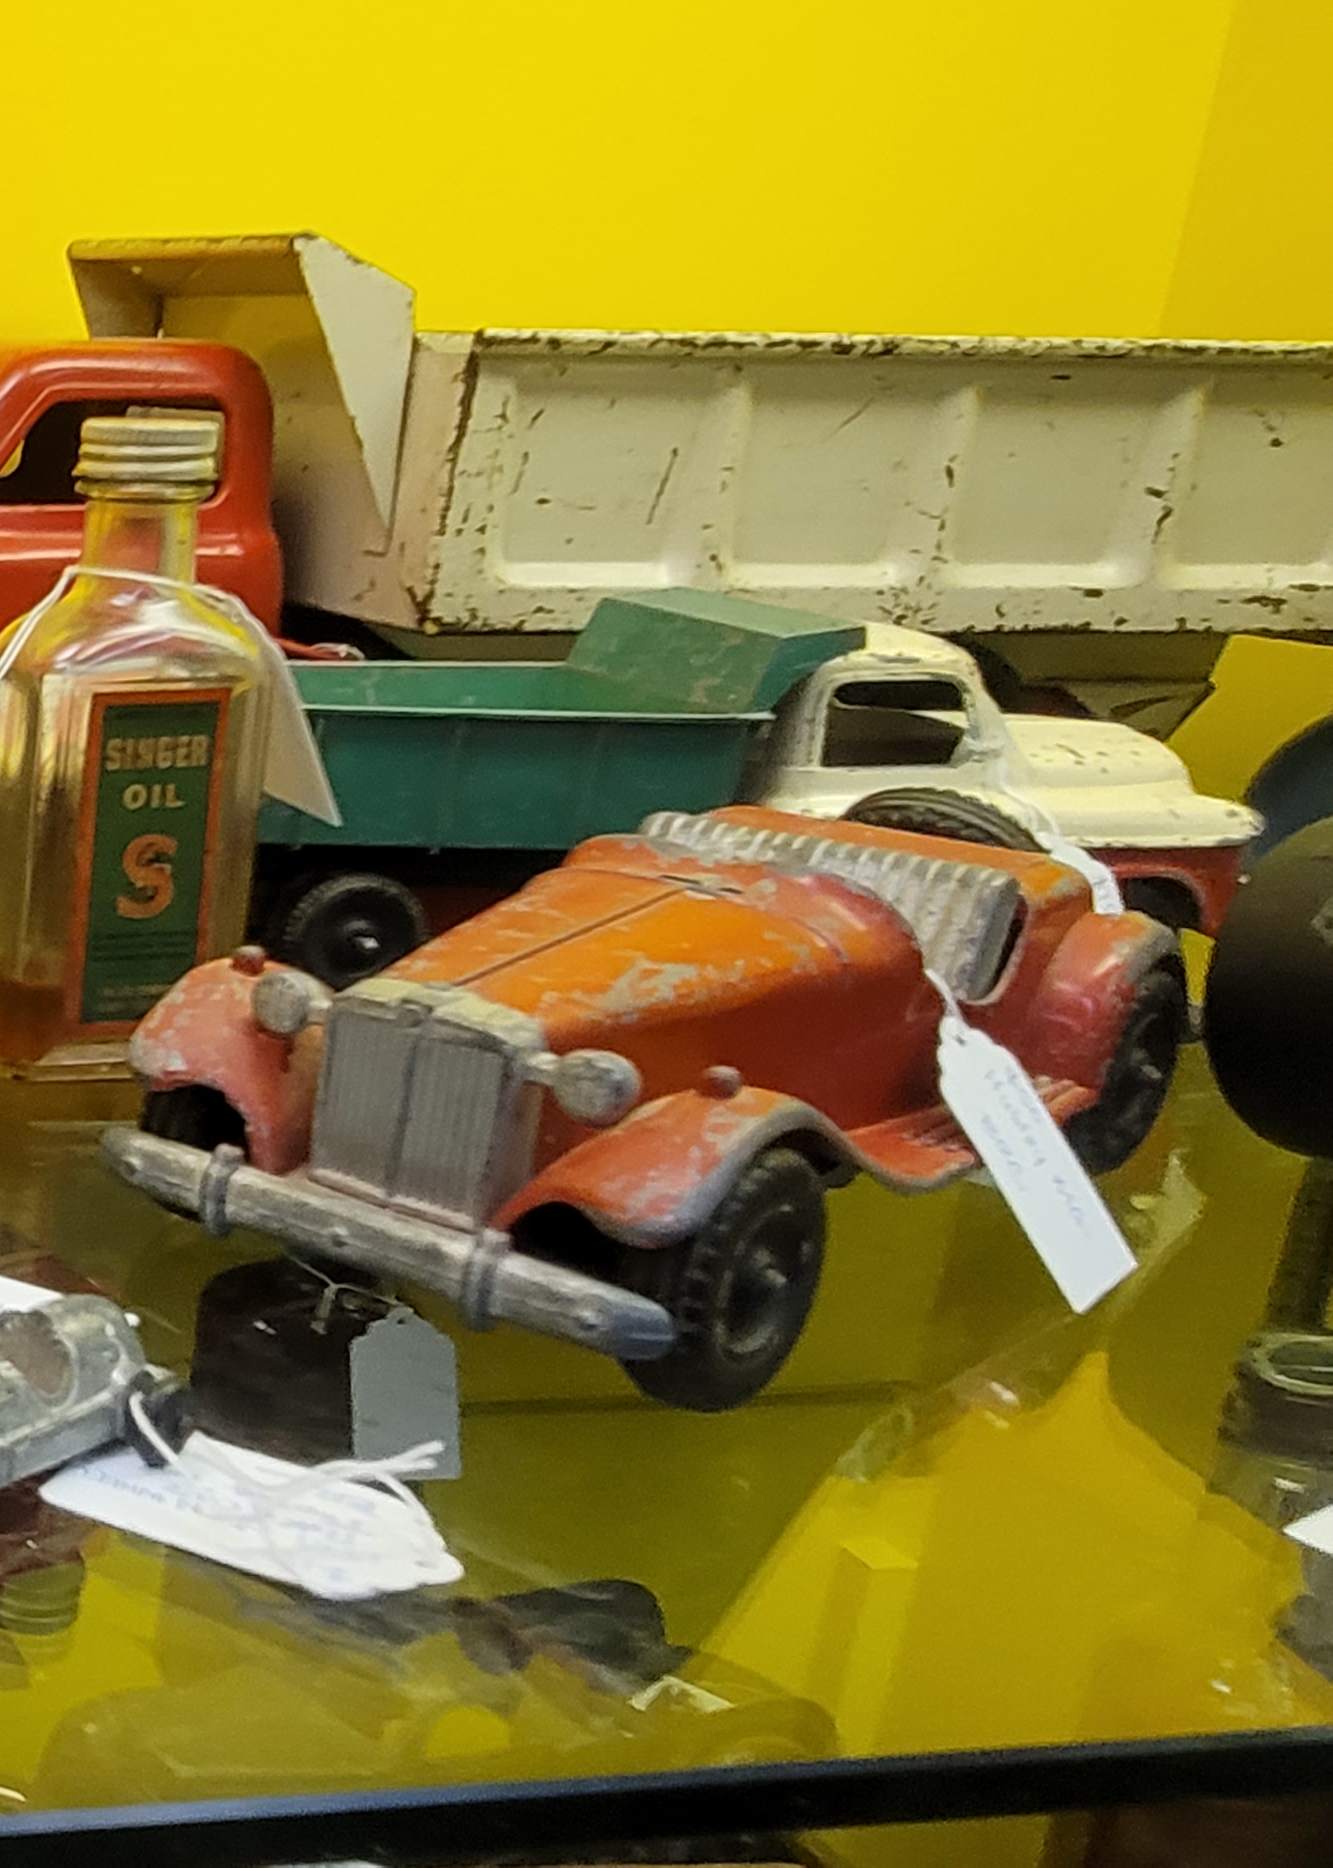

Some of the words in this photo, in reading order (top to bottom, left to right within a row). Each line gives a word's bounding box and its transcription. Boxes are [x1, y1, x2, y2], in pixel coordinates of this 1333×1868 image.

[104, 733, 210, 772] SINGER
[122, 783, 187, 811] OIL
[116, 833, 179, 920] S
